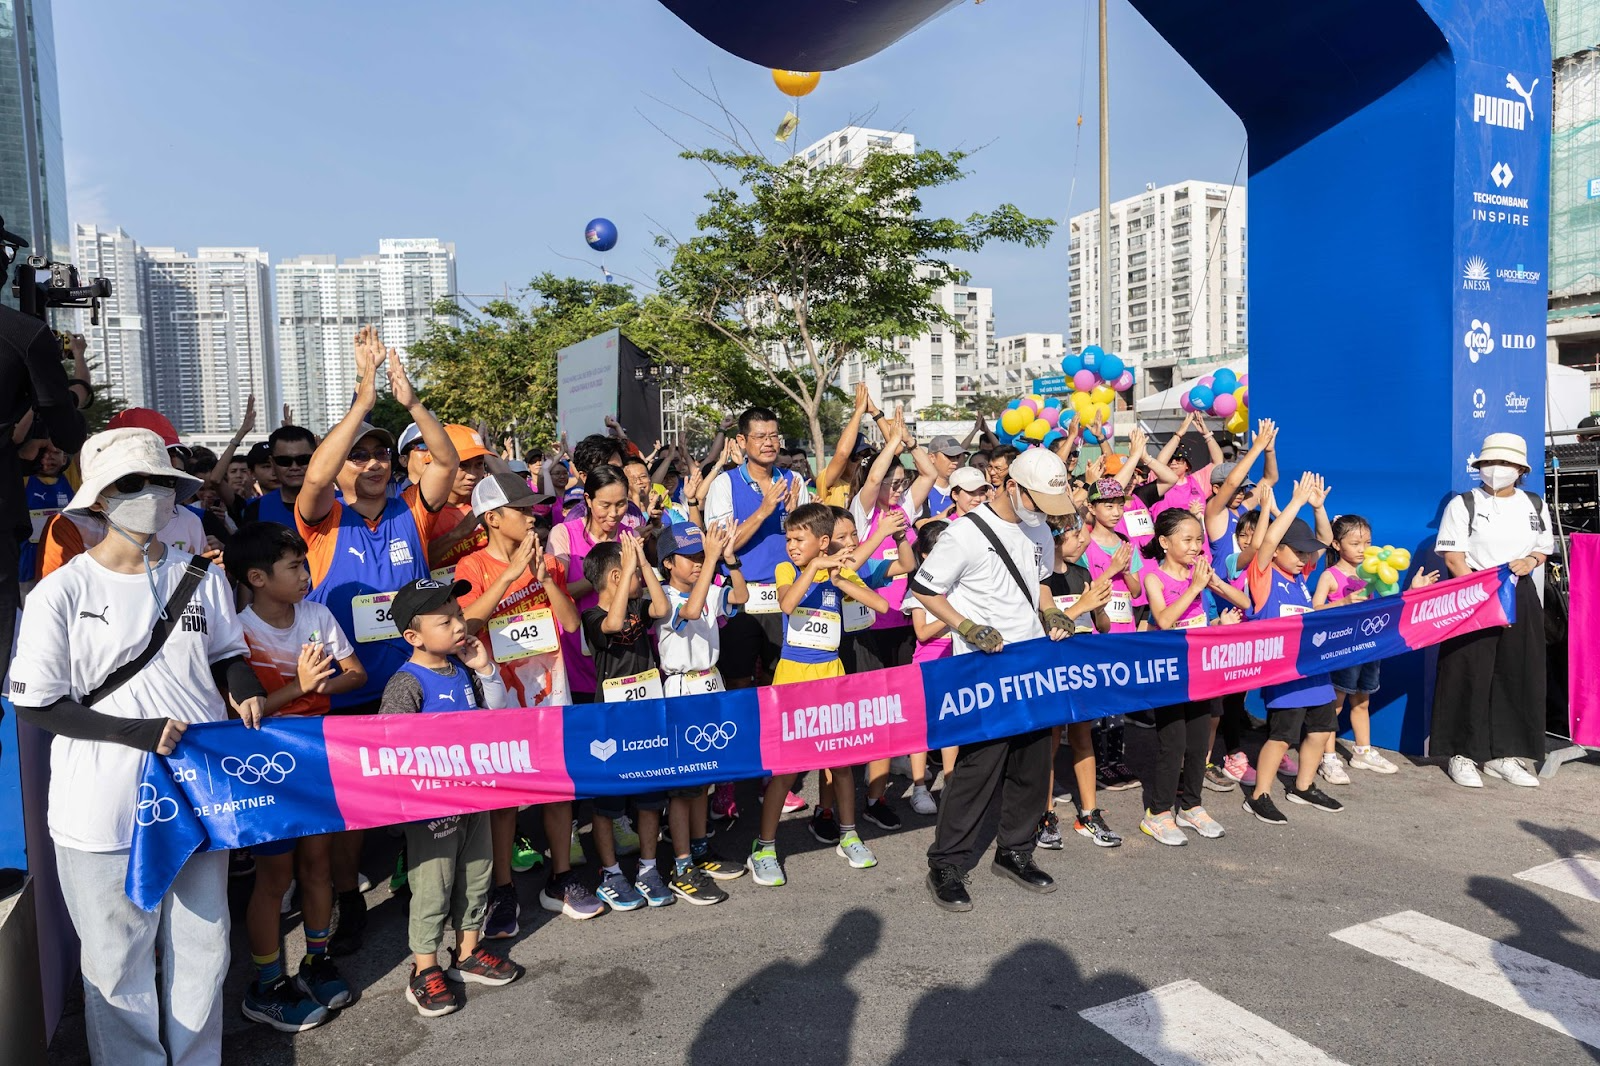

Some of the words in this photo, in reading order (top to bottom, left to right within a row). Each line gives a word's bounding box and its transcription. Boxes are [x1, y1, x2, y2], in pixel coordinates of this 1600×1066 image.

[1473, 93, 1525, 130] PUMA
[1473, 192, 1528, 209] TECHCOMBANK
[1473, 209, 1528, 226] INSPIRE
[1463, 279, 1490, 291] ANESSA
[1501, 334, 1536, 349] uno
[1137, 518, 1148, 526] 114
[529, 580, 544, 593] CH
[1113, 601, 1126, 611] 119
[1410, 591, 1457, 625] LAZADA
[375, 609, 394, 622] 36
[1432, 608, 1475, 629] VIETNAM
[510, 625, 539, 642] 043
[804, 621, 828, 634] 208
[1328, 626, 1354, 640] Lazada
[1202, 641, 1253, 672] LAZADA
[1254, 635, 1286, 663] RUN
[1320, 646, 1352, 661] WORLDWIDE
[1352, 640, 1377, 652] PARTNER
[1223, 666, 1262, 681] VIETNAM
[624, 686, 647, 701] 210
[938, 682, 995, 721] ADD
[999, 664, 1098, 703] FITNESS
[1097, 661, 1131, 687] TO
[1134, 657, 1180, 684] LIFE
[781, 701, 856, 742] LAZADA
[858, 693, 908, 729] RUN
[622, 735, 669, 752] Lazada
[814, 732, 875, 753] VIETNAM
[359, 744, 472, 777] LAZADA
[470, 739, 541, 775] RUN
[618, 766, 677, 780] WORLDWIDE
[677, 760, 719, 774] PARTNER
[410, 778, 497, 792] VIETNAM
[213, 794, 276, 816] PARTNER
[434, 826, 458, 840] FRIENDS
